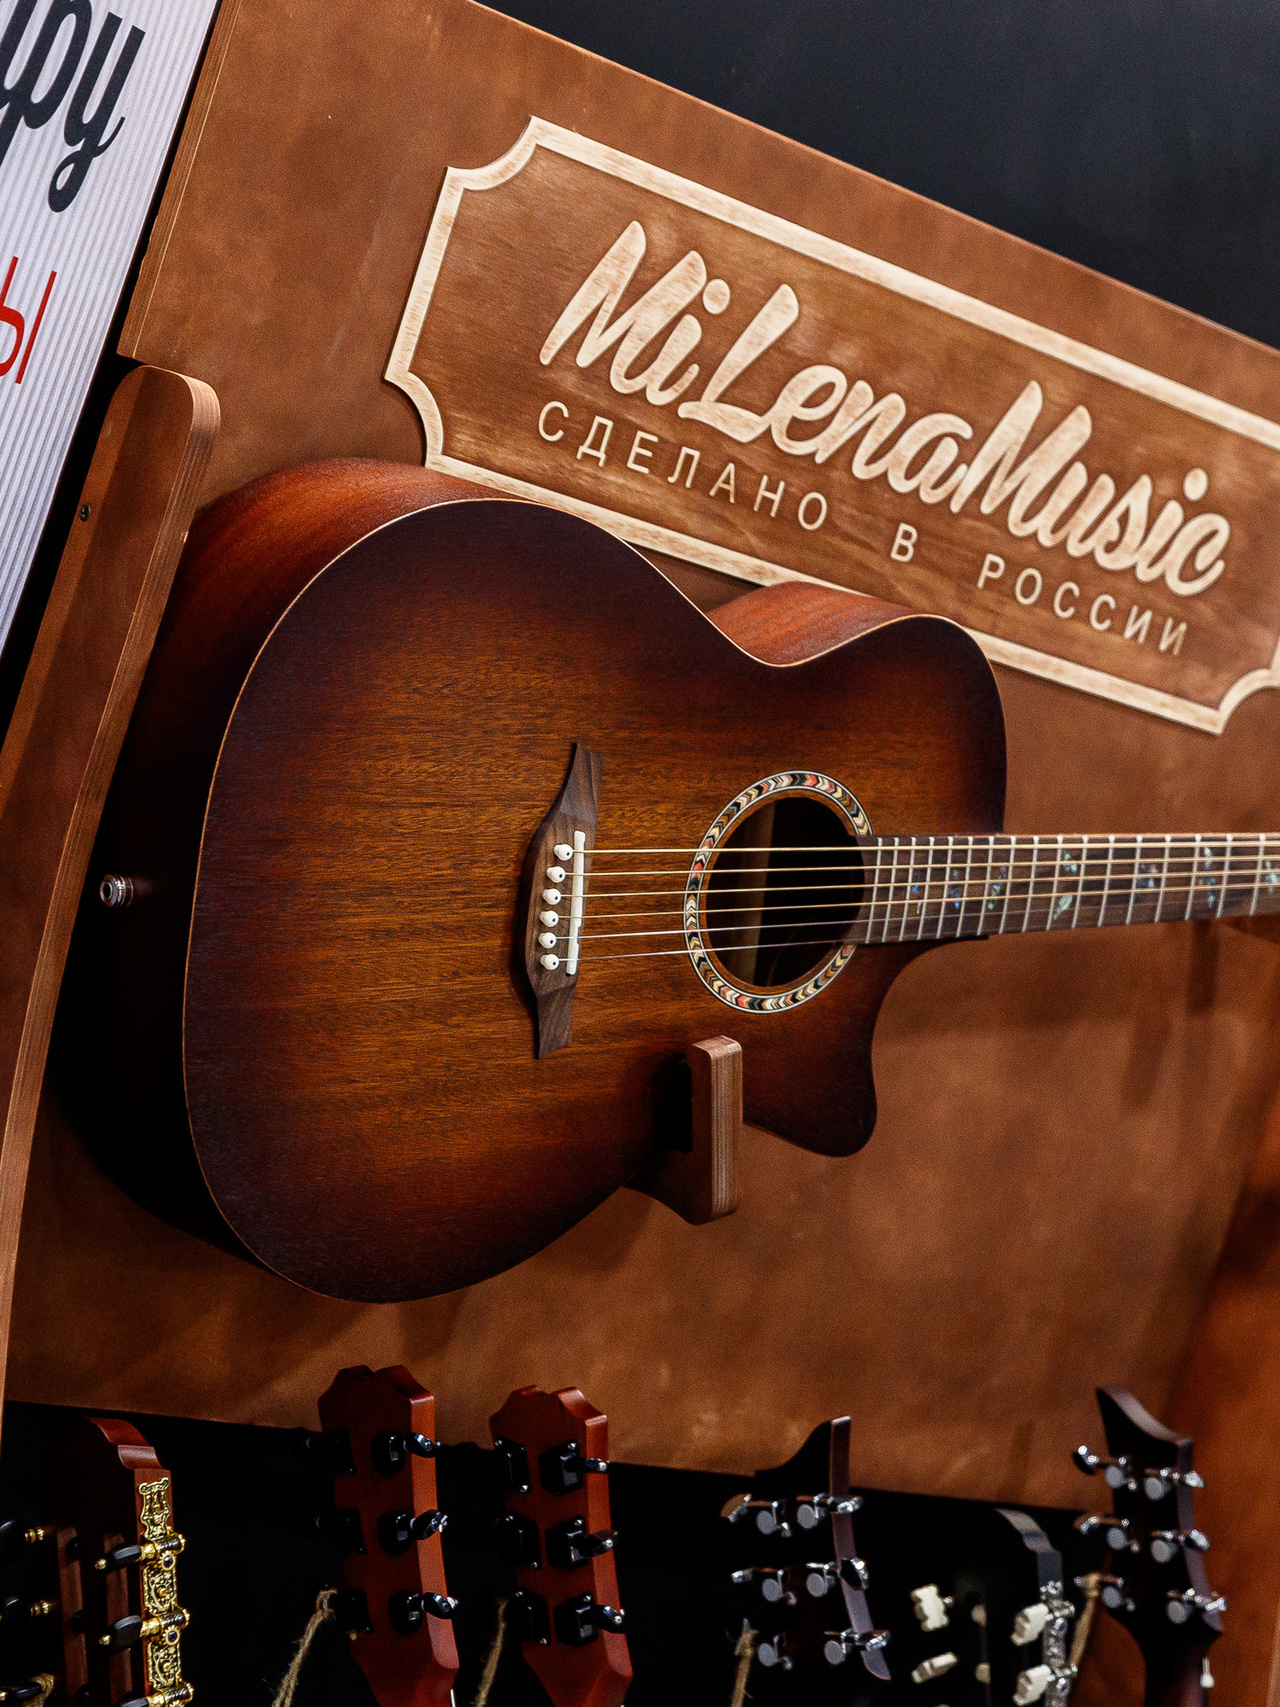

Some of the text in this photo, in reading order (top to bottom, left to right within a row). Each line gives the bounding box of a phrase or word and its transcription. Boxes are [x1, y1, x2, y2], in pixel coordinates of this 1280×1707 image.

[537, 400, 1188, 656] СДЕЛАНО В РОССИИ
